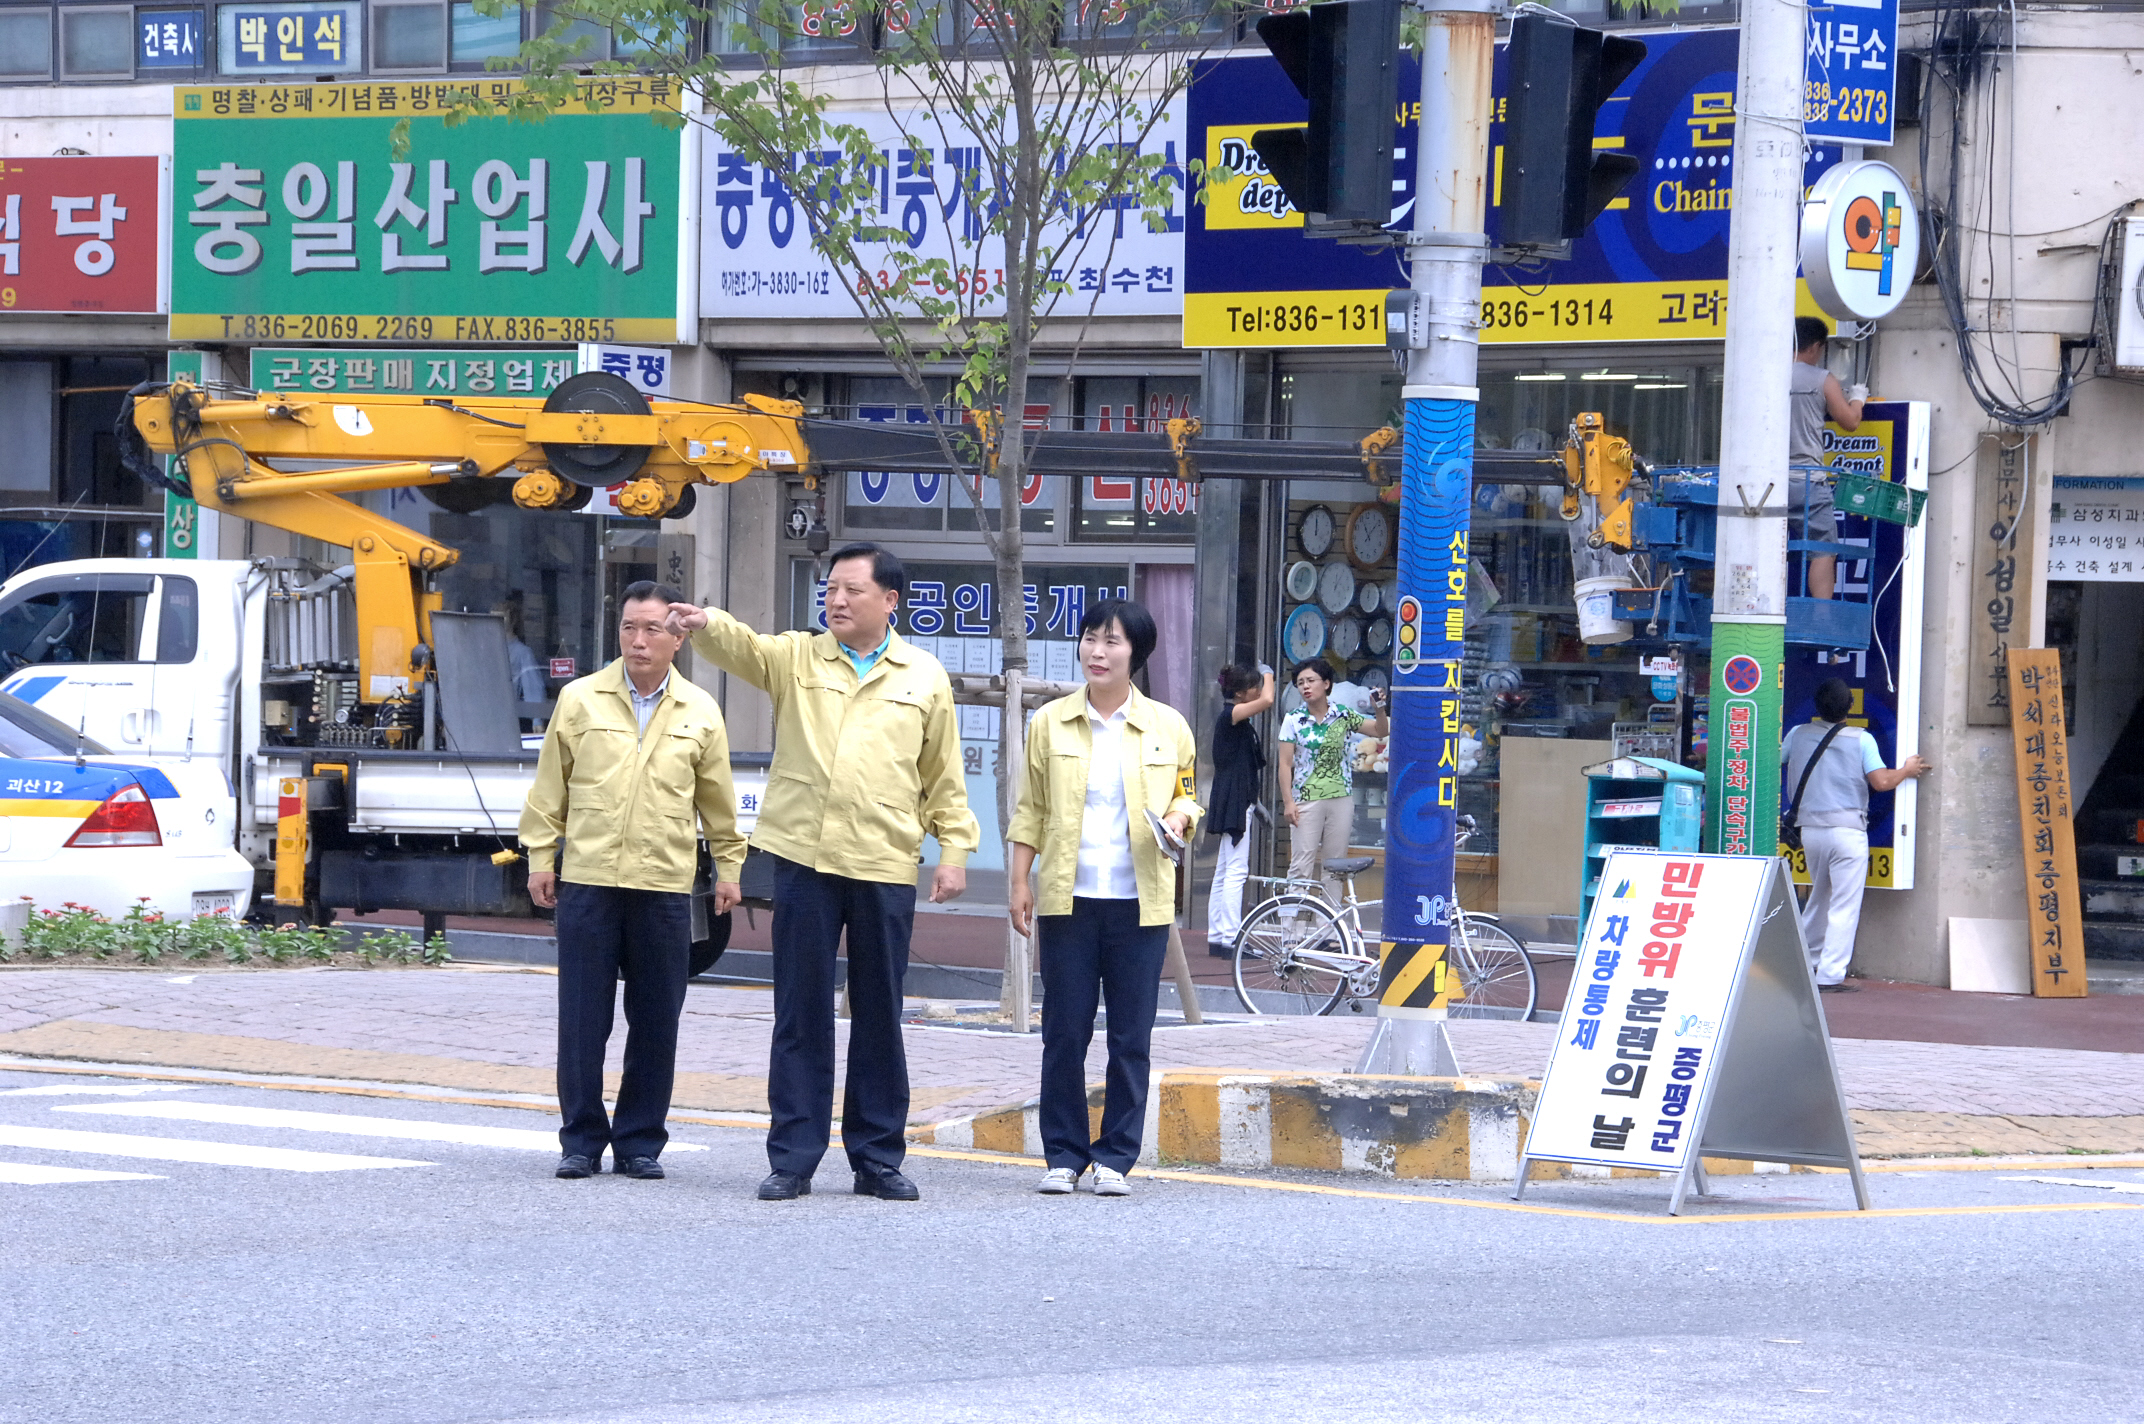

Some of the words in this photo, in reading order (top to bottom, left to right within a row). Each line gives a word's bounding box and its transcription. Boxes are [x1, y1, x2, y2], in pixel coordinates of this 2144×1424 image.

[144, 22, 198, 57] 건축사
[240, 14, 340, 62] 박인석
[1808, 21, 1887, 70] 사무소
[1806, 81, 1829, 100] 836
[1221, 138, 1270, 175] Dre
[1240, 178, 1297, 217] dep
[1654, 178, 1733, 213] Chain
[188, 157, 656, 277] 충일산업사
[1079, 266, 1173, 294] 최수천
[456, 317, 615, 343] FAX.836-3855
[1227, 305, 1380, 332] Tel:836-131
[270, 357, 414, 390] 군장판매
[426, 359, 573, 392] 지정업체
[602, 352, 665, 388] 증평
[1996, 445, 2019, 511] 법무사
[2053, 480, 2124, 490] FORMATION
[2073, 508, 2144, 523] 삼성치과
[2089, 536, 2127, 550] 이성일
[1444, 530, 1469, 642] 신호를
[1986, 515, 2017, 633] 이성일
[2075, 561, 2100, 573] 건축
[2108, 561, 2133, 574] 설계
[1437, 662, 1463, 811] 지킵시다
[6, 778, 40, 794] 괴산
[44, 779, 65, 794] 12
[1181, 776, 1195, 796] 민
[1725, 795, 1747, 854] 단속구간
[1638, 862, 1704, 979] 민방위
[1570, 914, 1629, 1051] 차량통제
[1601, 987, 1669, 1099] 훈련의
[1650, 1046, 1703, 1153] 증평군
[1590, 1114, 1636, 1151] 날
